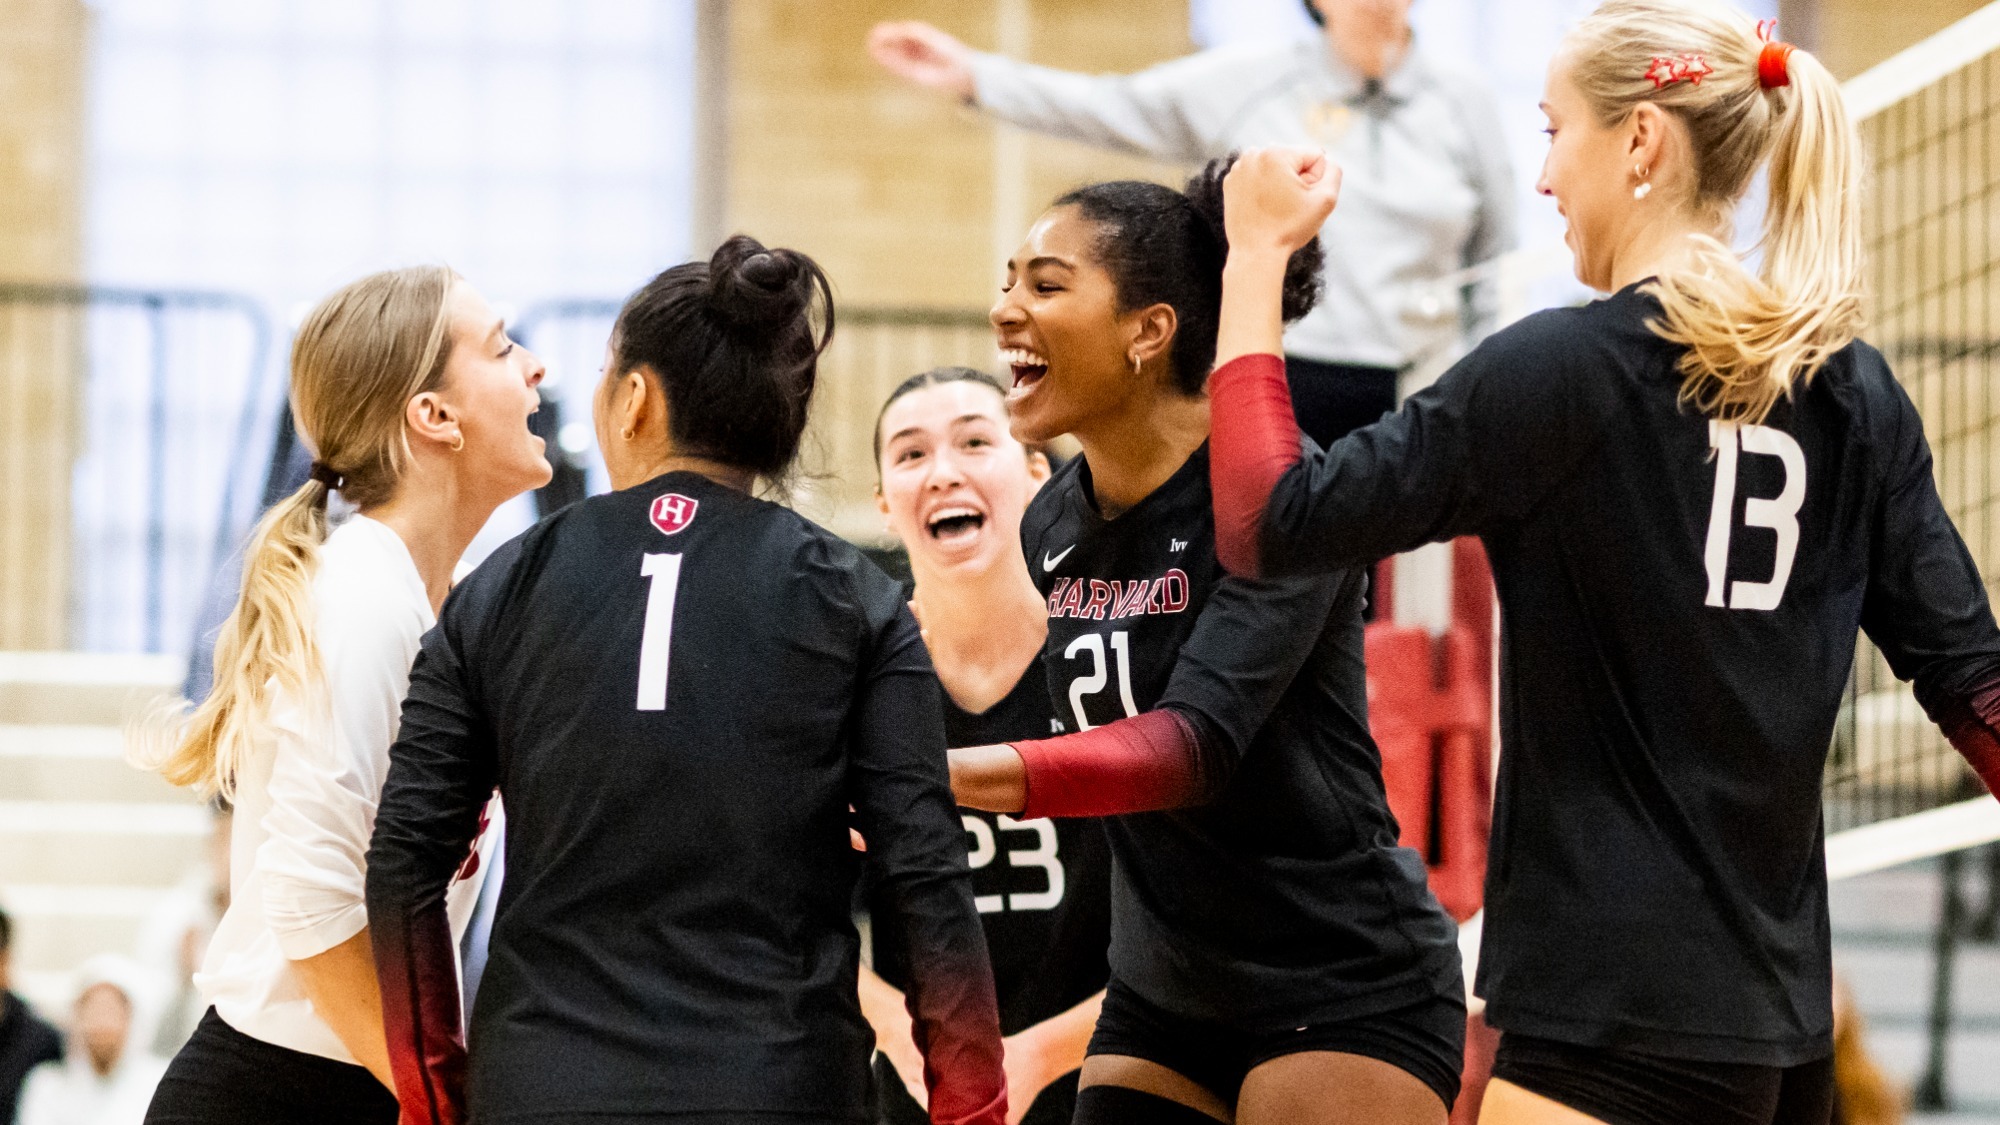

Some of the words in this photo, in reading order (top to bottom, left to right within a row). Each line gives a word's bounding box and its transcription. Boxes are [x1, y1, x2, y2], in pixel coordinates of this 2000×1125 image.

[657, 498, 687, 524] H
[1704, 419, 1806, 611] 13
[637, 553, 683, 711] 1
[1047, 568, 1189, 621] HARVARD
[1064, 631, 1139, 732] 21
[961, 814, 1065, 913] 23
